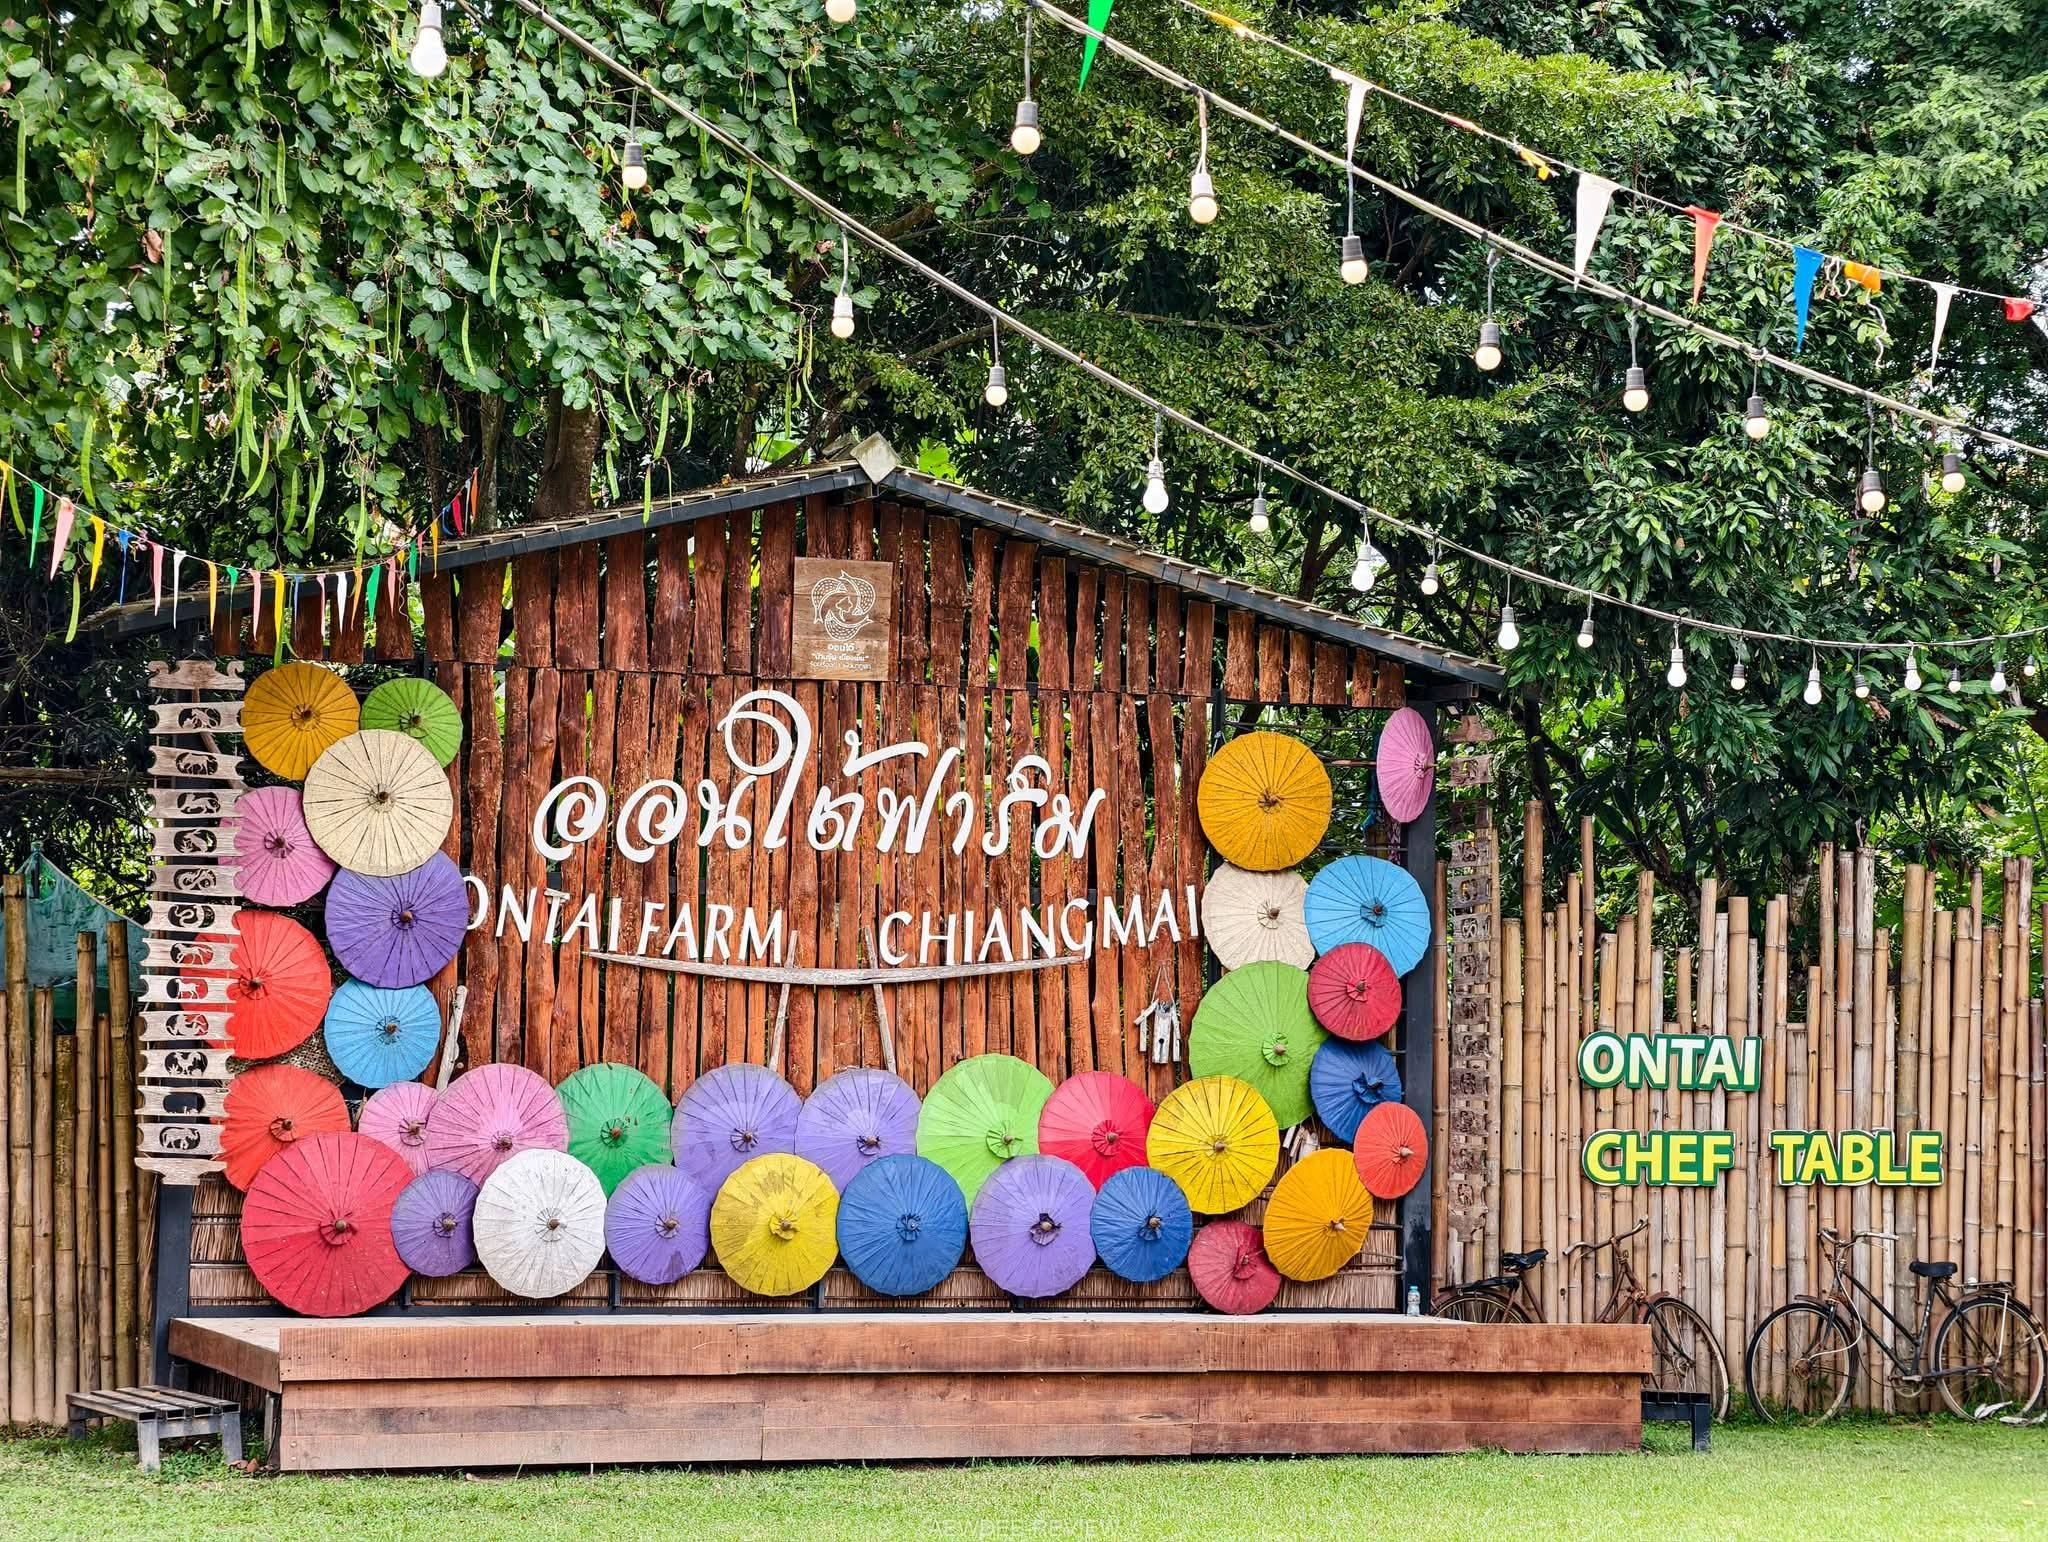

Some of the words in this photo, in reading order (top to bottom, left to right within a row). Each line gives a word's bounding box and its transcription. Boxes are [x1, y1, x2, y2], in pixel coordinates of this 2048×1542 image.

[532, 689, 1106, 863] ออนใต้ฟาร์ม
[637, 901, 784, 964] FARM
[1580, 1034, 1760, 1088] ONTAI
[1585, 1132, 1734, 1184] CHEF
[1771, 1132, 1943, 1184] TABLE
